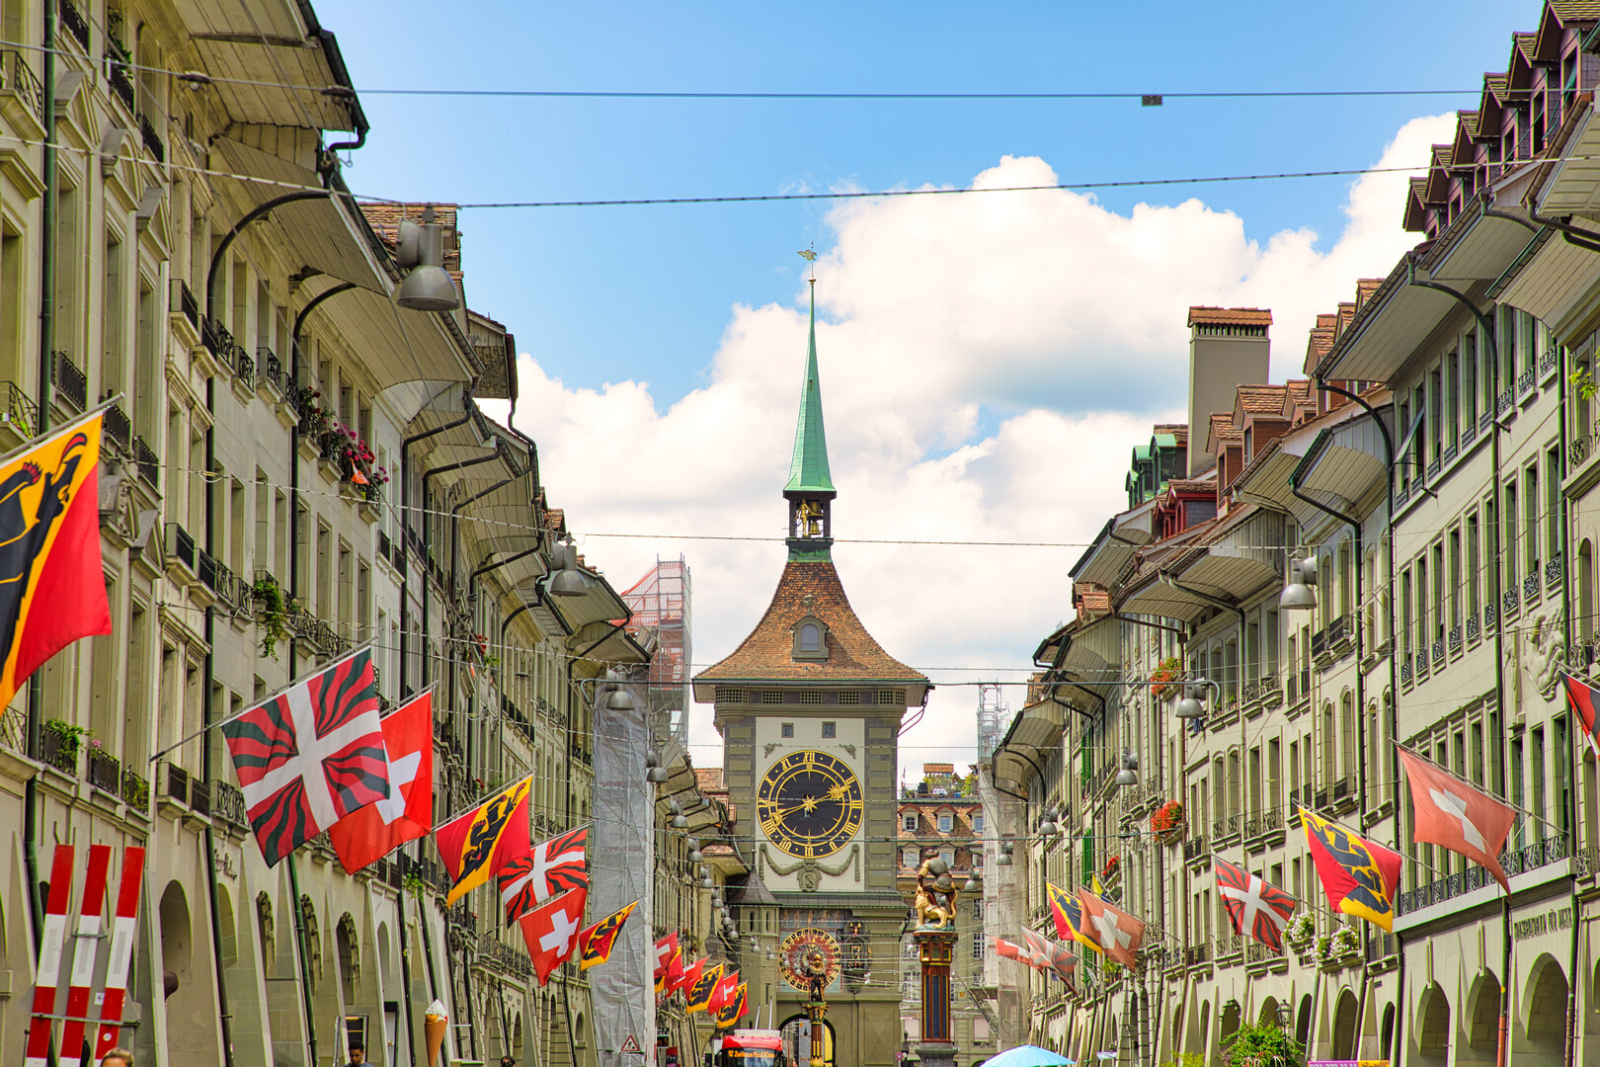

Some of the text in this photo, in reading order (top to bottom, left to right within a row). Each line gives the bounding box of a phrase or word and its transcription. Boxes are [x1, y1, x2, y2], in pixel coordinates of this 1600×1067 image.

[803, 752, 815, 763] XII
[781, 758, 792, 772] XI
[830, 758, 837, 769] I
[764, 775, 774, 787] X
[845, 775, 856, 785] II
[851, 800, 862, 809] III
[762, 819, 776, 835] VIII
[843, 821, 857, 836] IIII
[805, 846, 814, 857] VI
[829, 841, 838, 851] V
